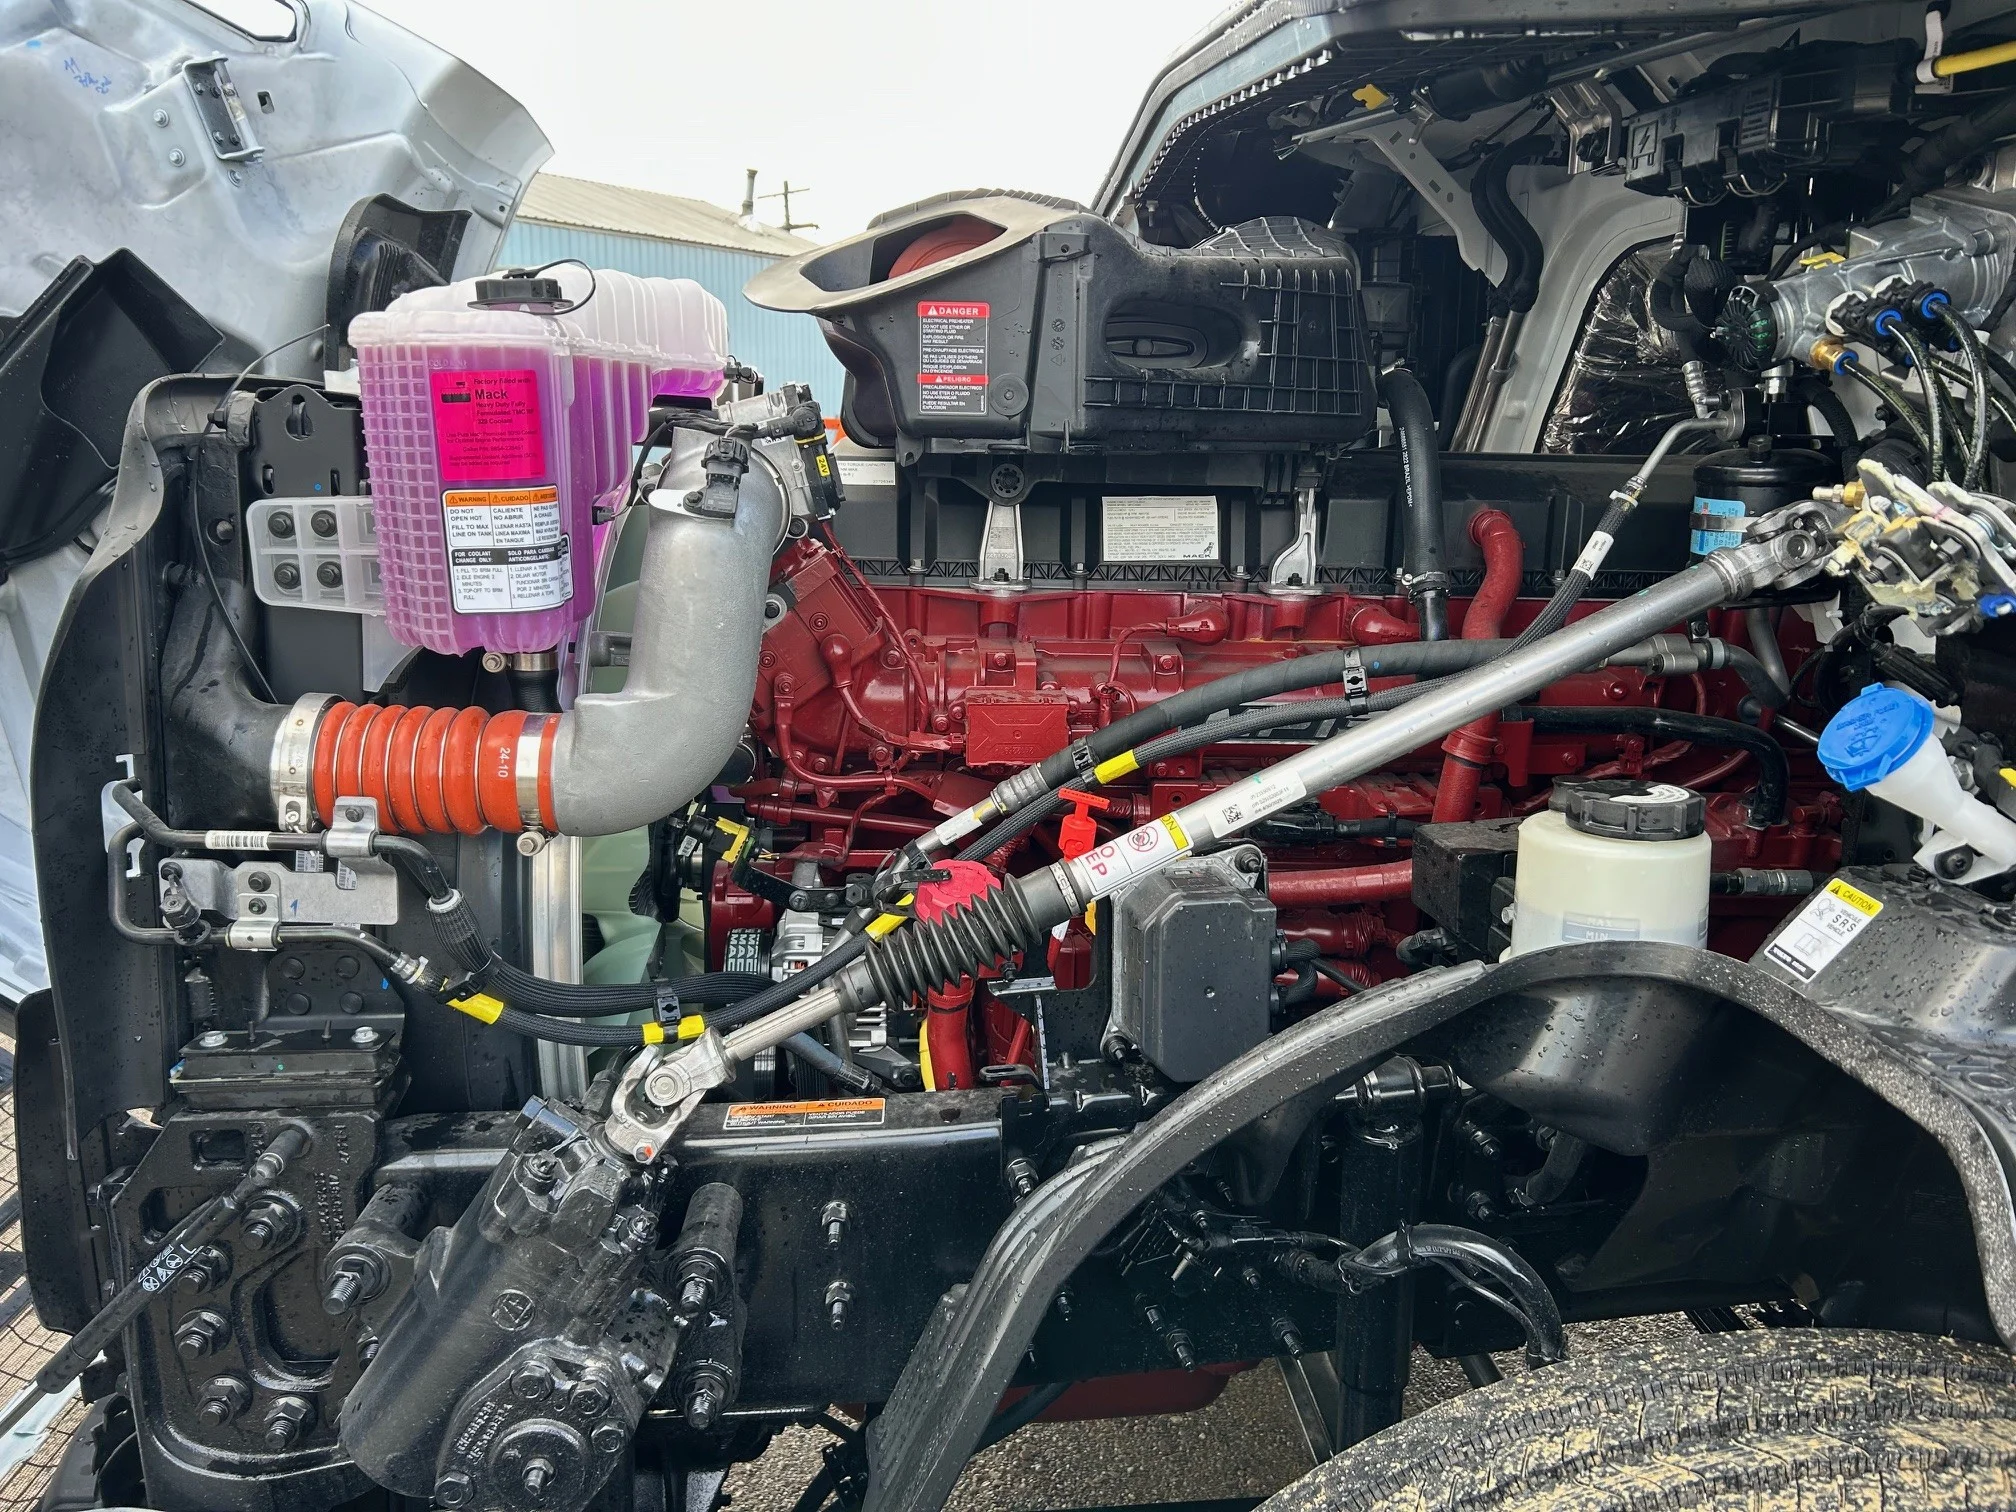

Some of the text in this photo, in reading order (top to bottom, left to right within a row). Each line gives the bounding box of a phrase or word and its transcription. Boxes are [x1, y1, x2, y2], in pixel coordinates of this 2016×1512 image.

[475, 389, 507, 400] Mack
[818, 458, 828, 474] 24V
[497, 747, 510, 778] 24-10
[1842, 890, 1874, 911] CAUTION
[1586, 918, 1613, 927] MAX
[1826, 923, 1846, 938] VEHICLE
[1585, 930, 1609, 940] MIN
[728, 934, 739, 971] MAC
[737, 934, 747, 971] MAC
[746, 934, 756, 971] MAC
